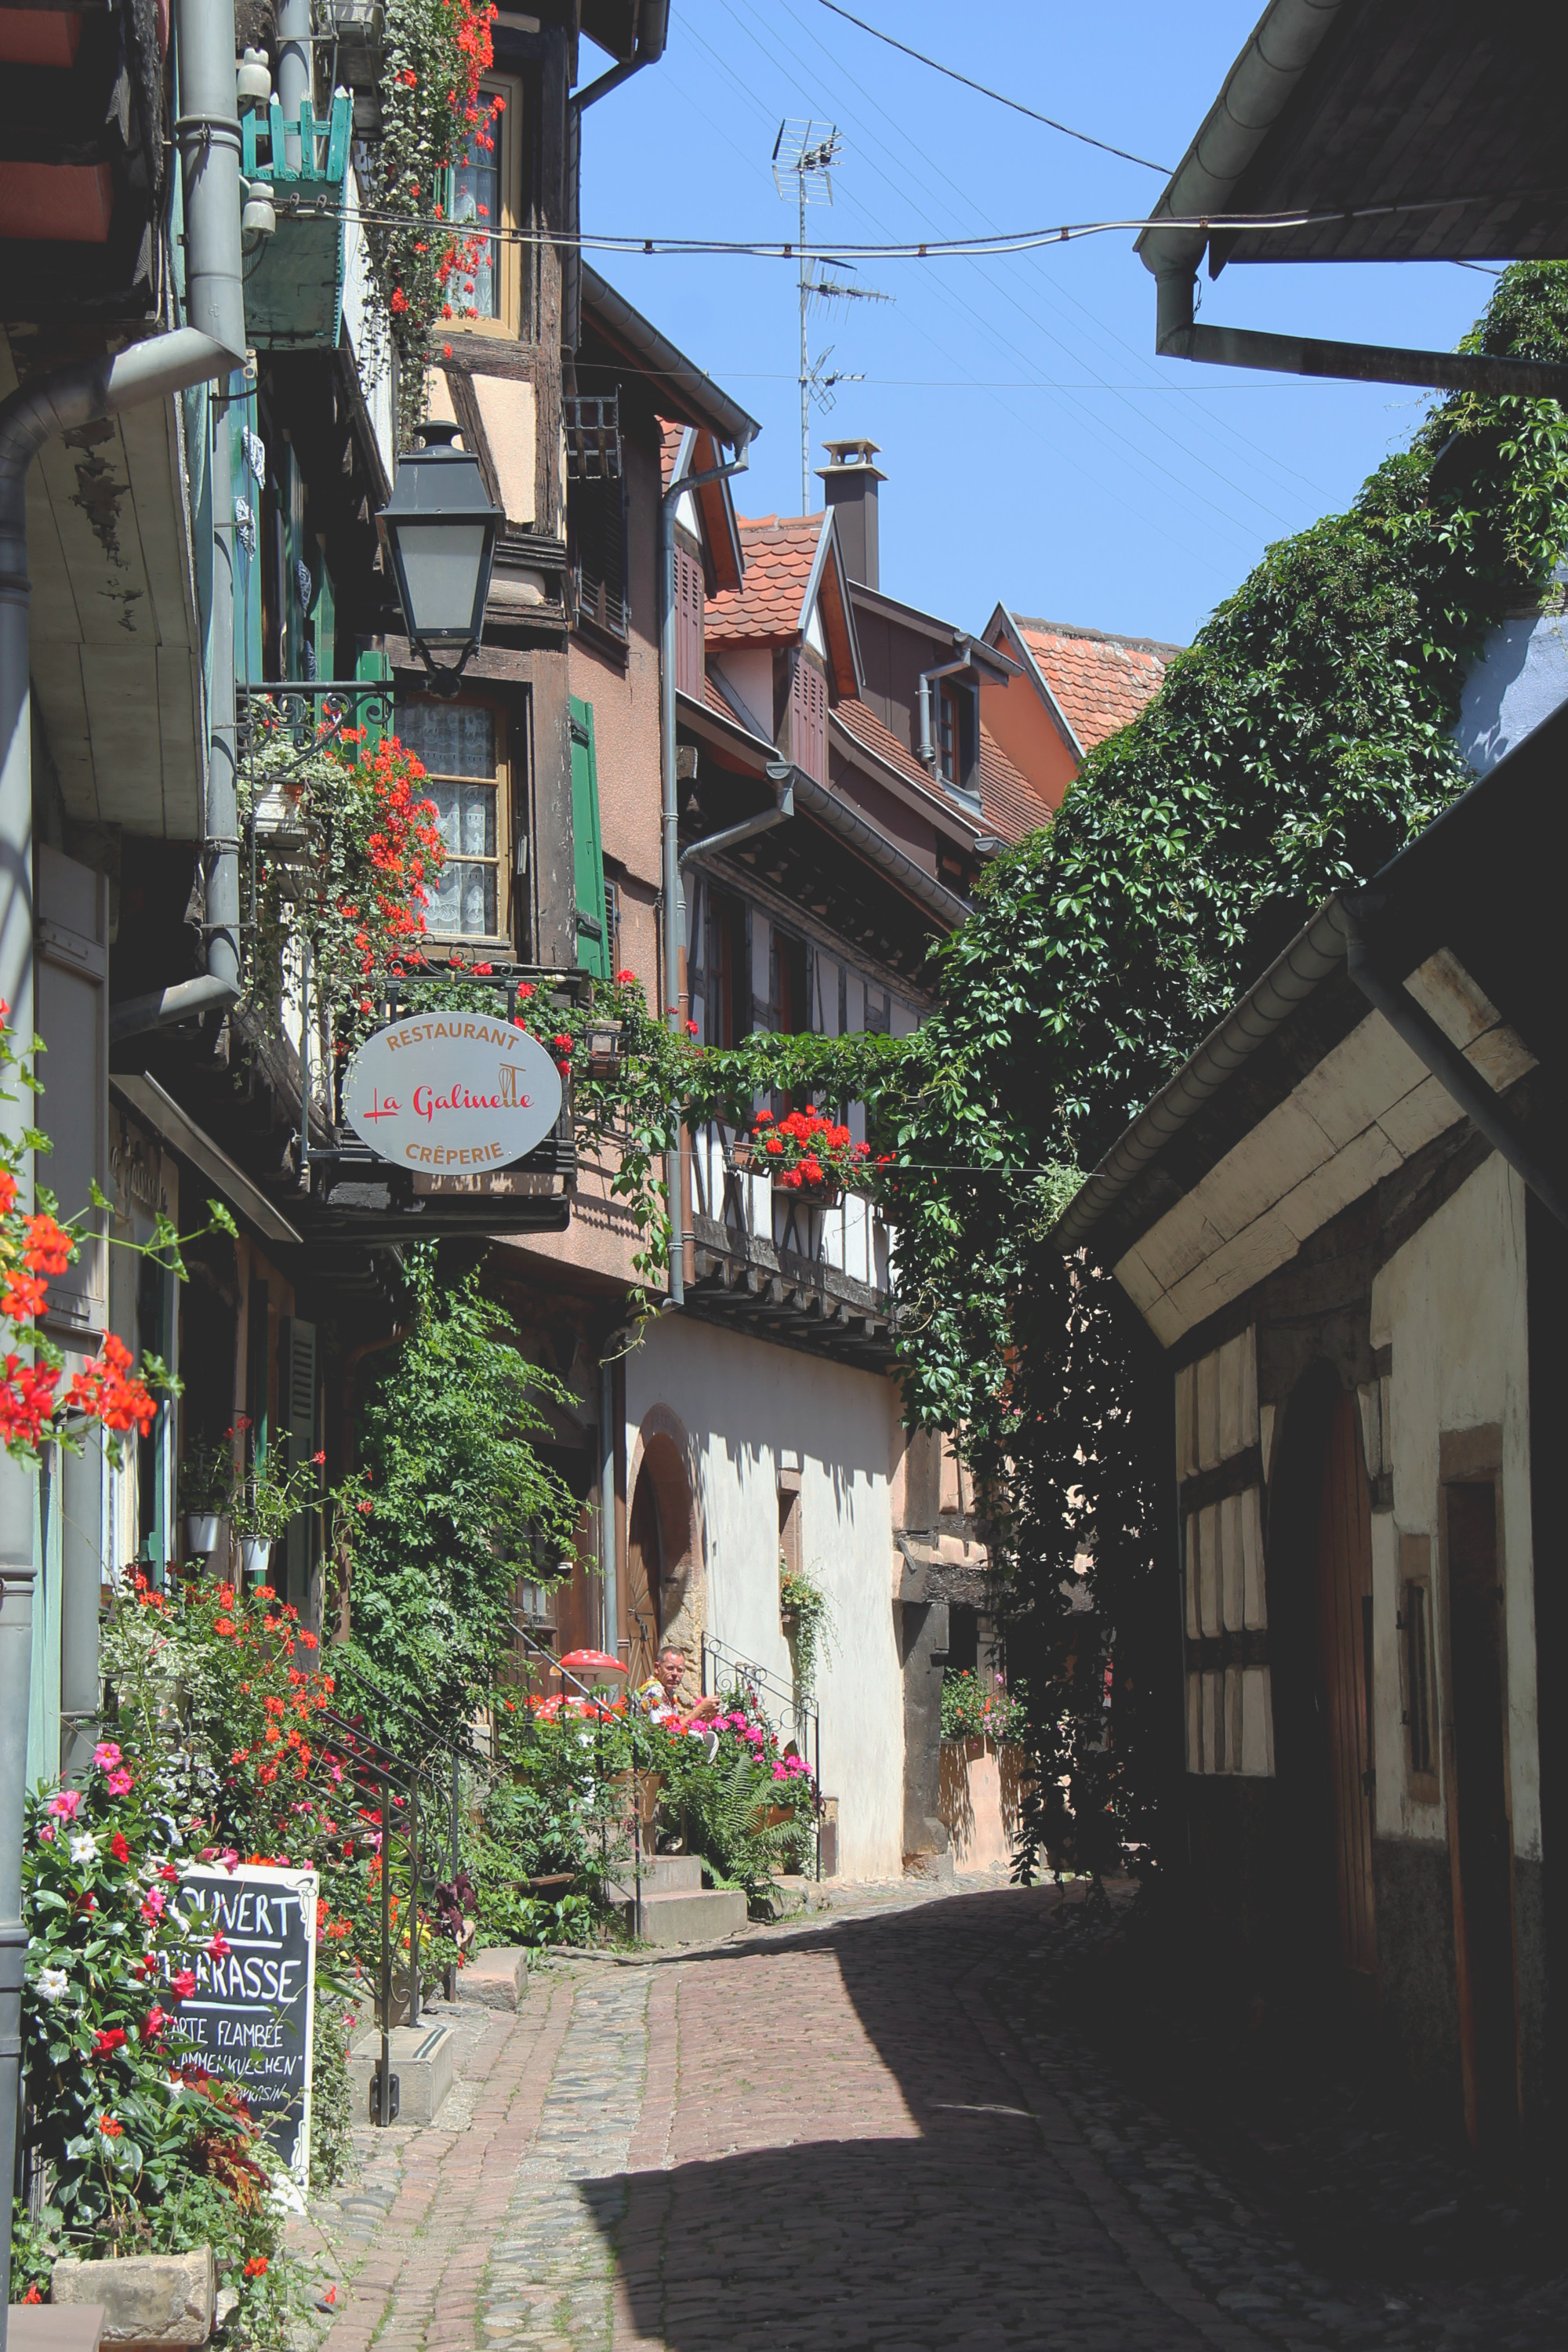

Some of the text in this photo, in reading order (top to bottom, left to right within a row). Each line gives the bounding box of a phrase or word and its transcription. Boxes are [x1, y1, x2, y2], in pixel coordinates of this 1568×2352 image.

[386, 1022, 519, 1051] RESTAURANT
[363, 1087, 402, 1124] La
[405, 1142, 504, 1165] CRÊPERIE
